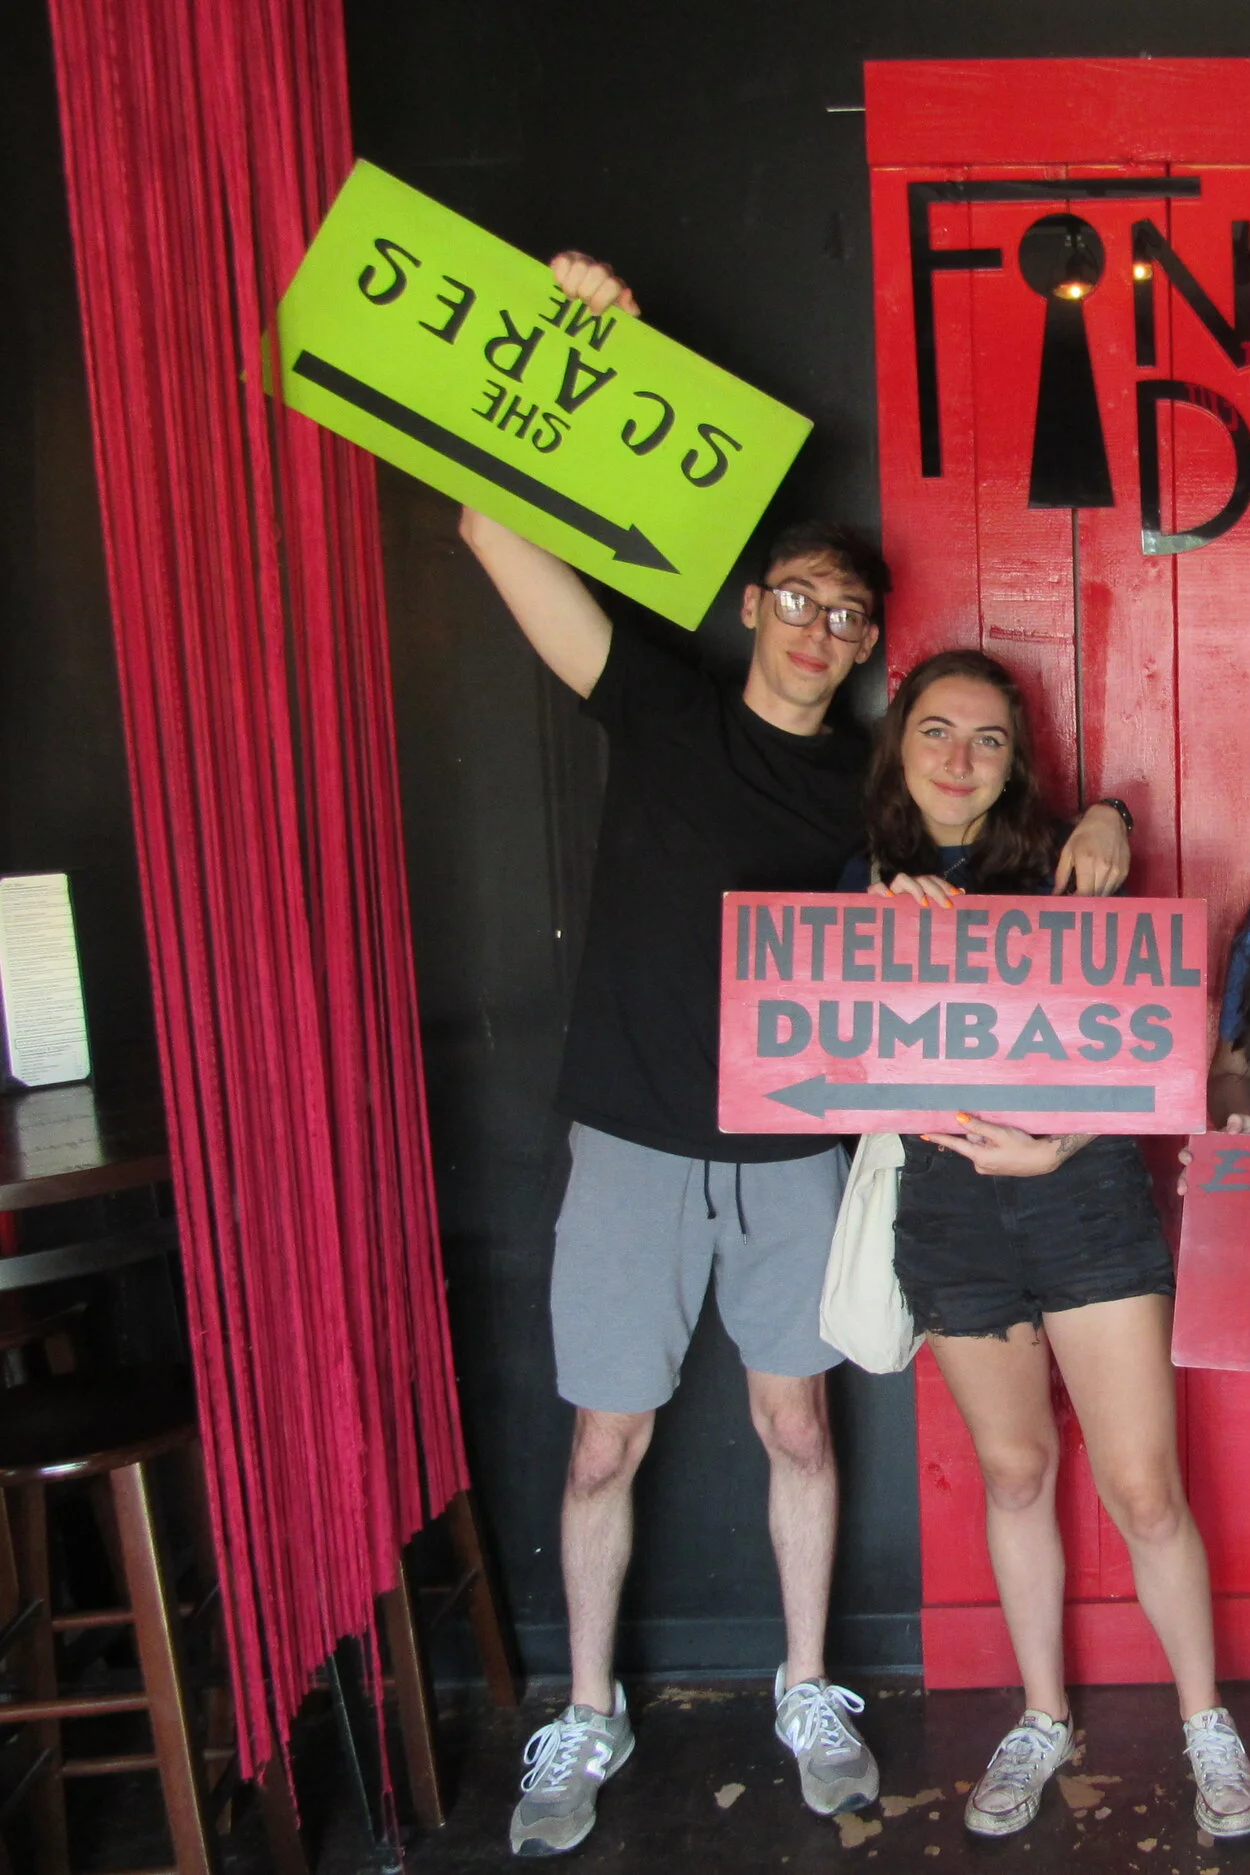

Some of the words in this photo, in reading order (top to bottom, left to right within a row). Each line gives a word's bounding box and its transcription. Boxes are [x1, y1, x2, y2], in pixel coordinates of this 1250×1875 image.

[538, 284, 617, 352] ME
[357, 237, 744, 488] SCARES
[471, 379, 572, 454] SHE
[735, 904, 1202, 988] INTELLECTUAL
[756, 1000, 1175, 1063] DUMBASS
